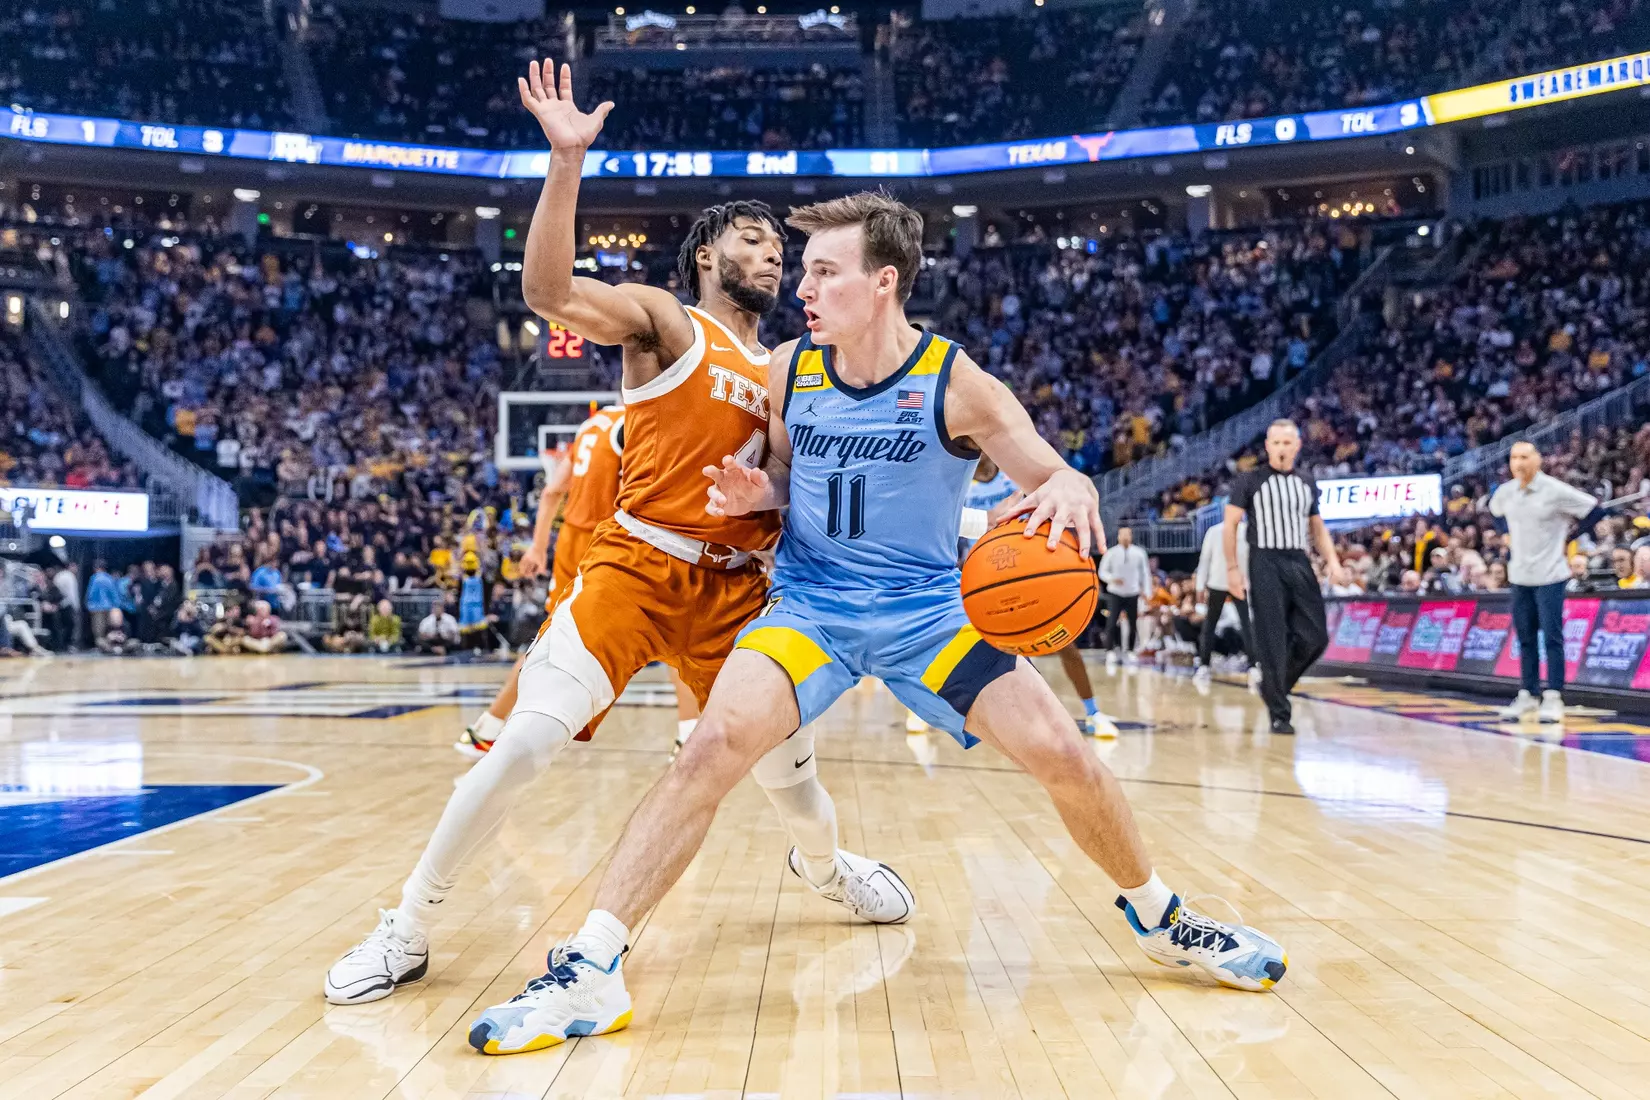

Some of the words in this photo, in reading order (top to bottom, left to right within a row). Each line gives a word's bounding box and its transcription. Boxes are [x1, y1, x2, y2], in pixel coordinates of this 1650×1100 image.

[1215, 123, 1253, 146] FLS
[1274, 118, 1297, 141] 0
[1340, 112, 1378, 134] TOL
[343, 142, 459, 169] MARQUETTE
[1007, 142, 1067, 166] TEXAS
[548, 330, 585, 359] 22
[573, 434, 597, 476] 5
[790, 423, 927, 468] Marquette
[827, 472, 866, 539] 11
